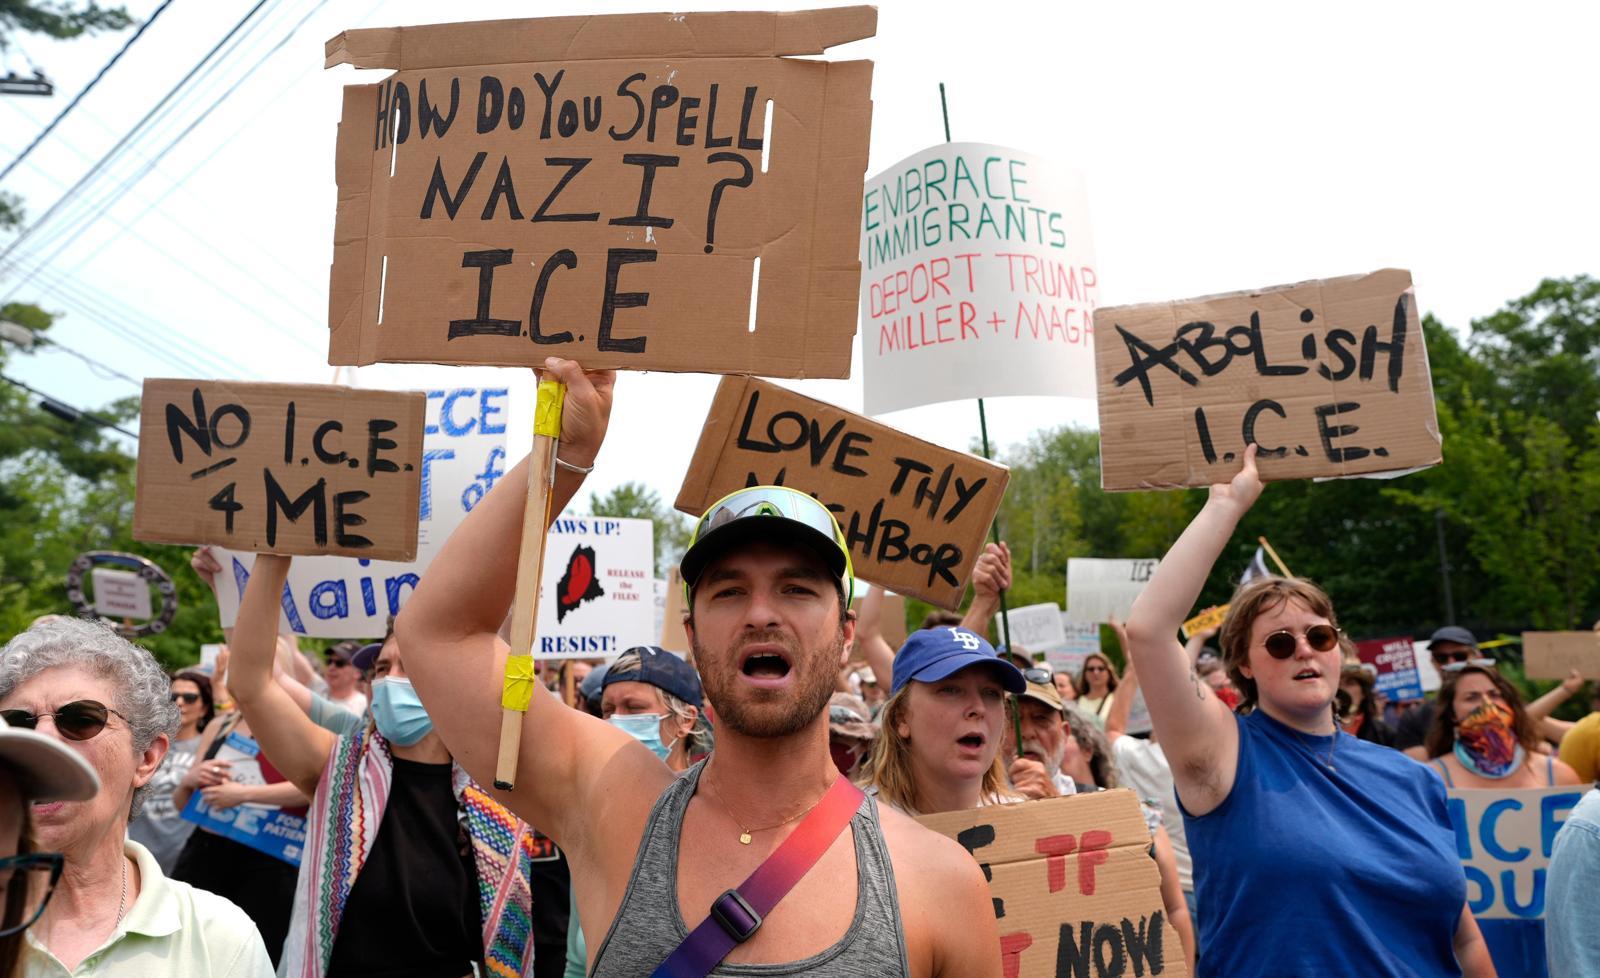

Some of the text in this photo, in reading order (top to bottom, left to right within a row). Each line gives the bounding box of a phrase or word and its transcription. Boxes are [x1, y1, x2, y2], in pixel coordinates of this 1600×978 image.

[374, 78, 459, 150] HOW
[608, 72, 765, 150] SPELL
[419, 151, 755, 254] NAZI?
[864, 156, 1030, 231] EMBRACE
[867, 202, 1066, 270] IMMIGRANTS
[870, 253, 982, 318] DEPORT
[879, 301, 1094, 355] MILLER + MAGA
[166, 386, 415, 478] NO I.C.E.
[735, 390, 988, 524] LOVE THY
[1194, 399, 1390, 465] I.C.E.
[208, 482, 243, 536] 4
[263, 467, 376, 548] ME
[461, 446, 506, 512] of
[552, 519, 620, 536] AWS UP!
[232, 556, 421, 634] ain
[607, 568, 646, 579] RELEASE
[619, 580, 632, 589] the
[541, 635, 616, 654] RESIST!
[262, 822, 307, 843] PATIEN
[1055, 910, 1165, 978] NOW
